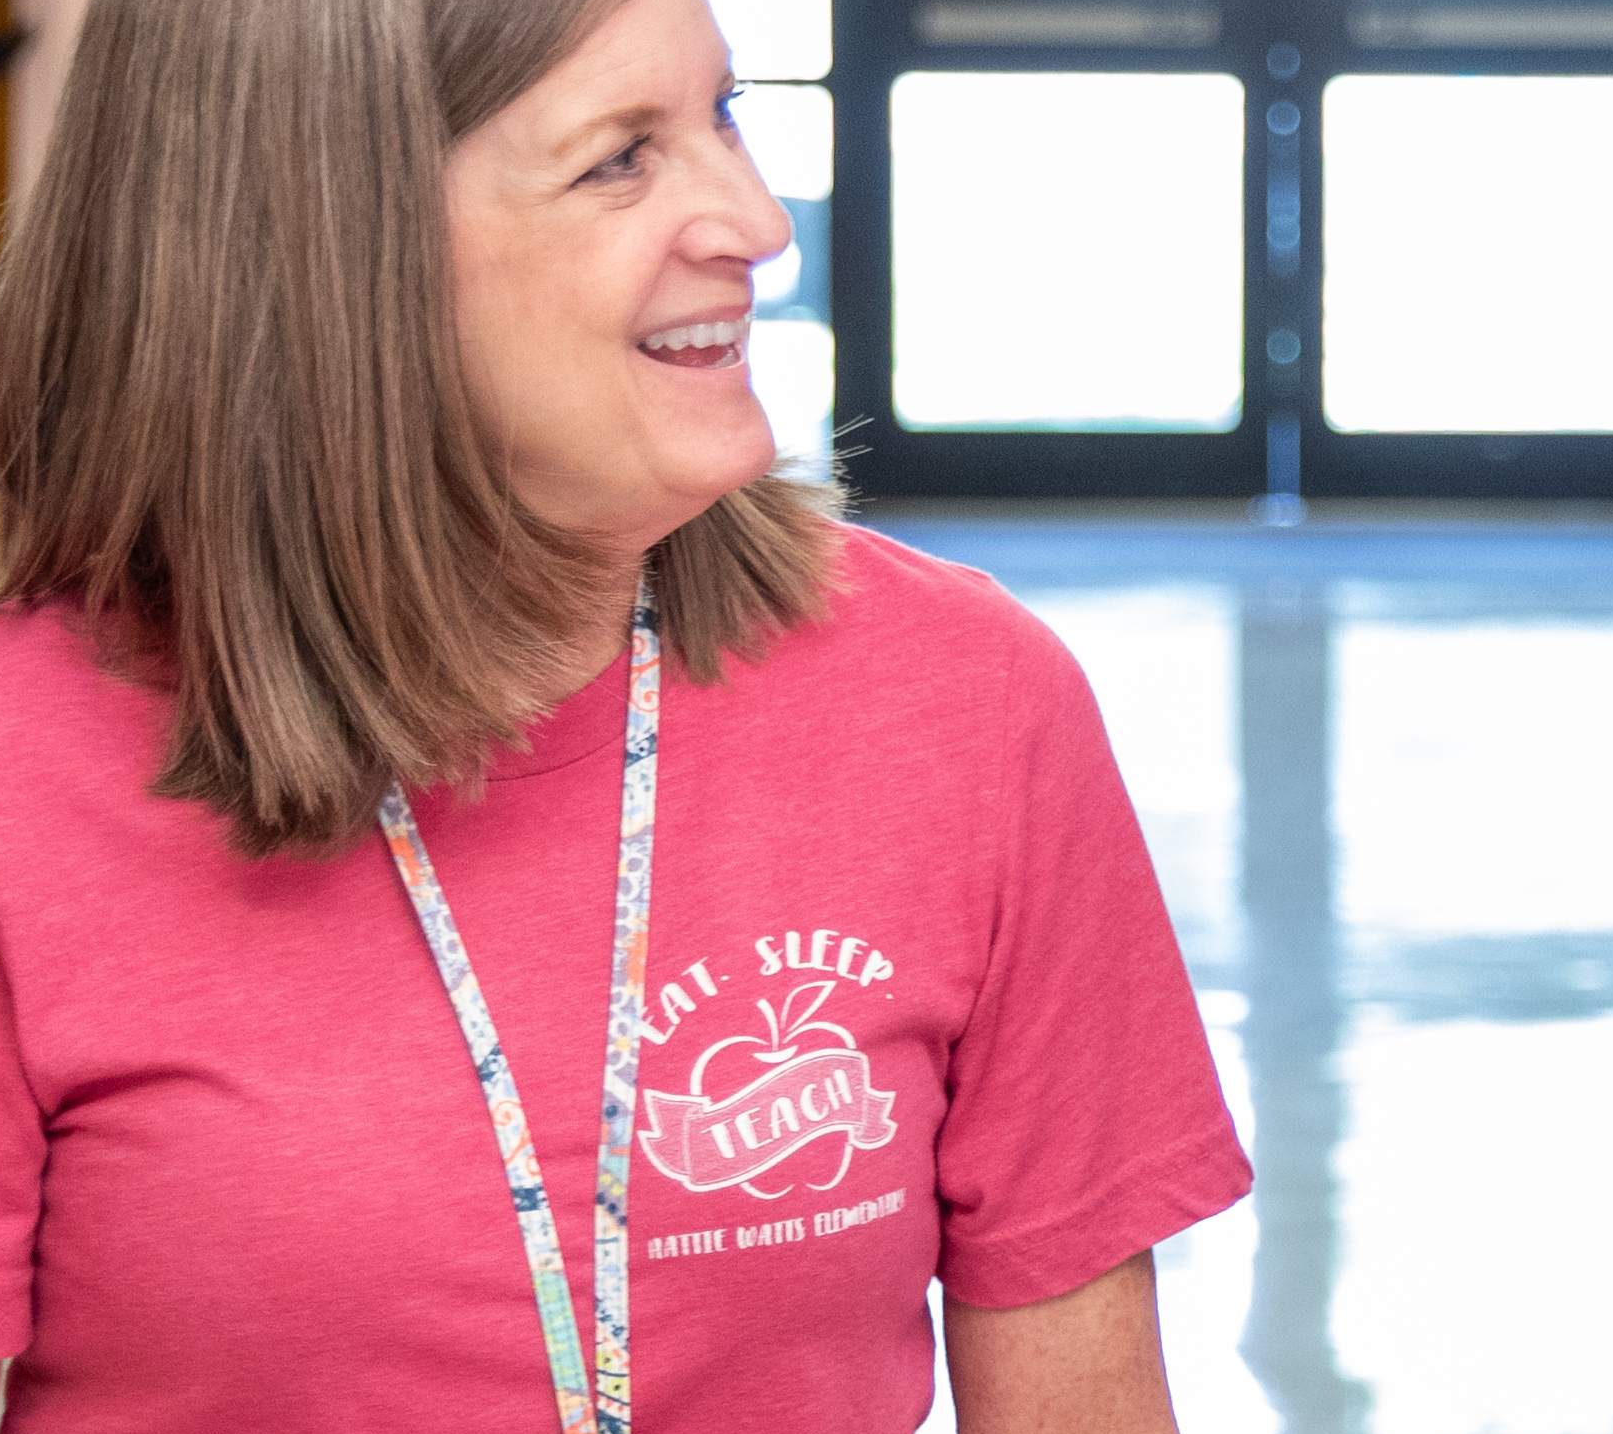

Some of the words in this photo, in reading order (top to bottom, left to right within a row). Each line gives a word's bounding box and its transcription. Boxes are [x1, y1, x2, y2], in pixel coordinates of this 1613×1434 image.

[638, 956, 730, 1045] EAT.
[755, 929, 894, 1000] SLEEP.
[647, 1229, 728, 1259] HATTIE
[736, 1217, 806, 1249] WATTS
